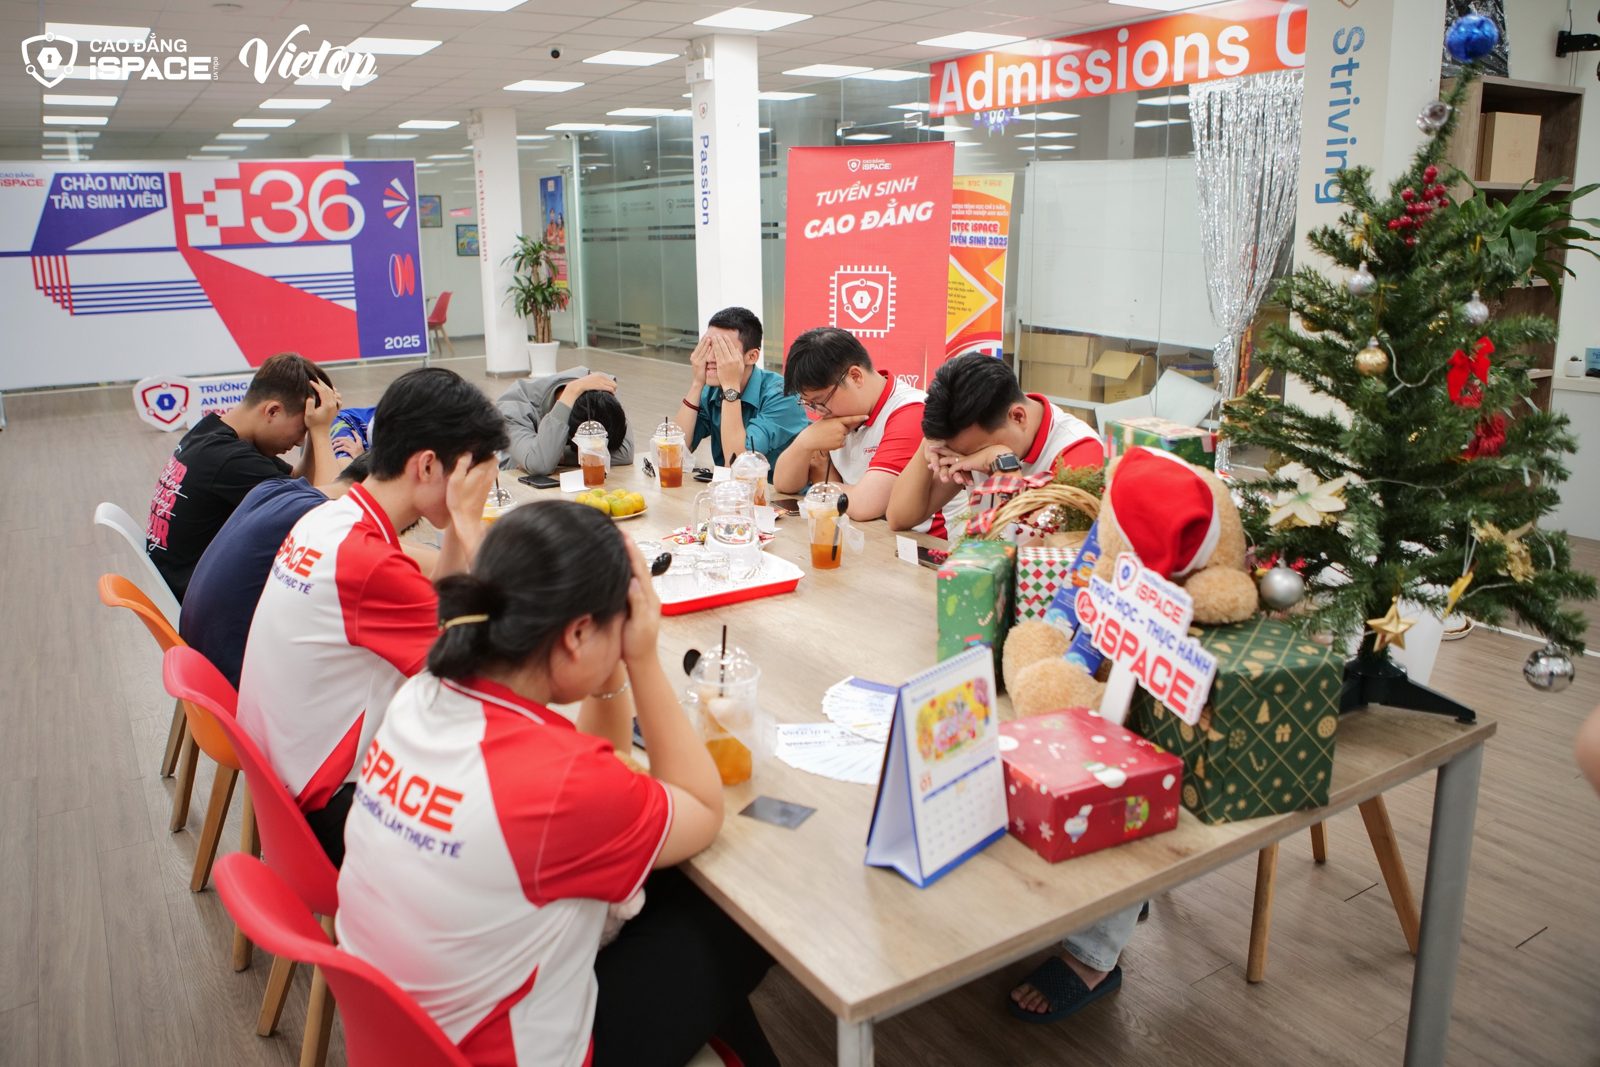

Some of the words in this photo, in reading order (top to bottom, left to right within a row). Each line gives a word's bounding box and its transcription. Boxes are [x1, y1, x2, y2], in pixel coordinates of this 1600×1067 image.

[937, 25, 1250, 115] Admissions
[1315, 26, 1365, 204] Striving
[51, 193, 84, 209] TÂN
[87, 195, 125, 209] SINH
[127, 191, 164, 208] VIÊN
[61, 174, 107, 191] CHÀO
[111, 173, 162, 190] MỪNG
[700, 135, 710, 226] Passion
[816, 181, 872, 207] TUYỂN
[875, 176, 918, 197] SINH
[804, 214, 855, 239] CAO
[861, 199, 935, 231] ĐẲNG
[384, 335, 421, 350] 2025
[201, 397, 217, 405] AN
[1136, 581, 1184, 624] iSPACE
[1093, 612, 1195, 714] iSPACE
